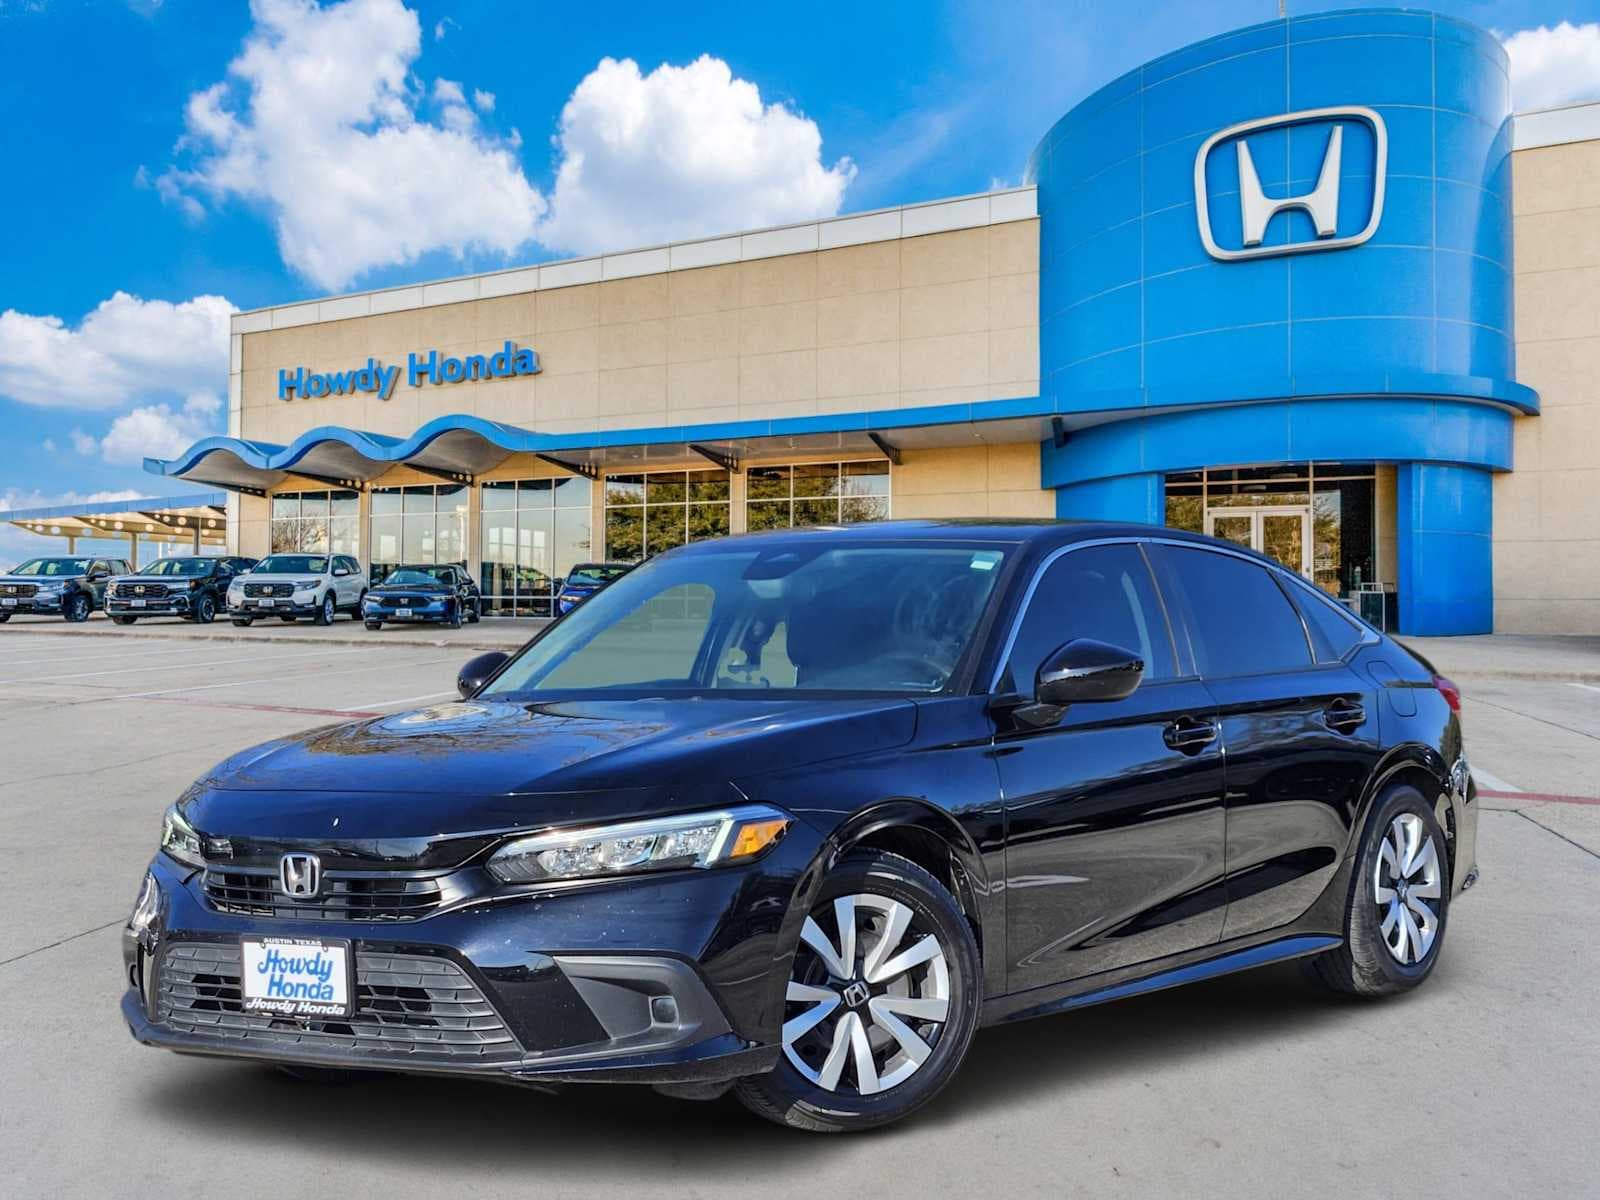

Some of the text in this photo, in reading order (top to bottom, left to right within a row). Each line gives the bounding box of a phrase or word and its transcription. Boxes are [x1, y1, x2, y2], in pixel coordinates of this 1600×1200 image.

[278, 341, 543, 401] Howdy Honda
[257, 949, 333, 982] Howdy
[267, 974, 334, 1000] Honda
[246, 998, 346, 1015] Howdy Honda
